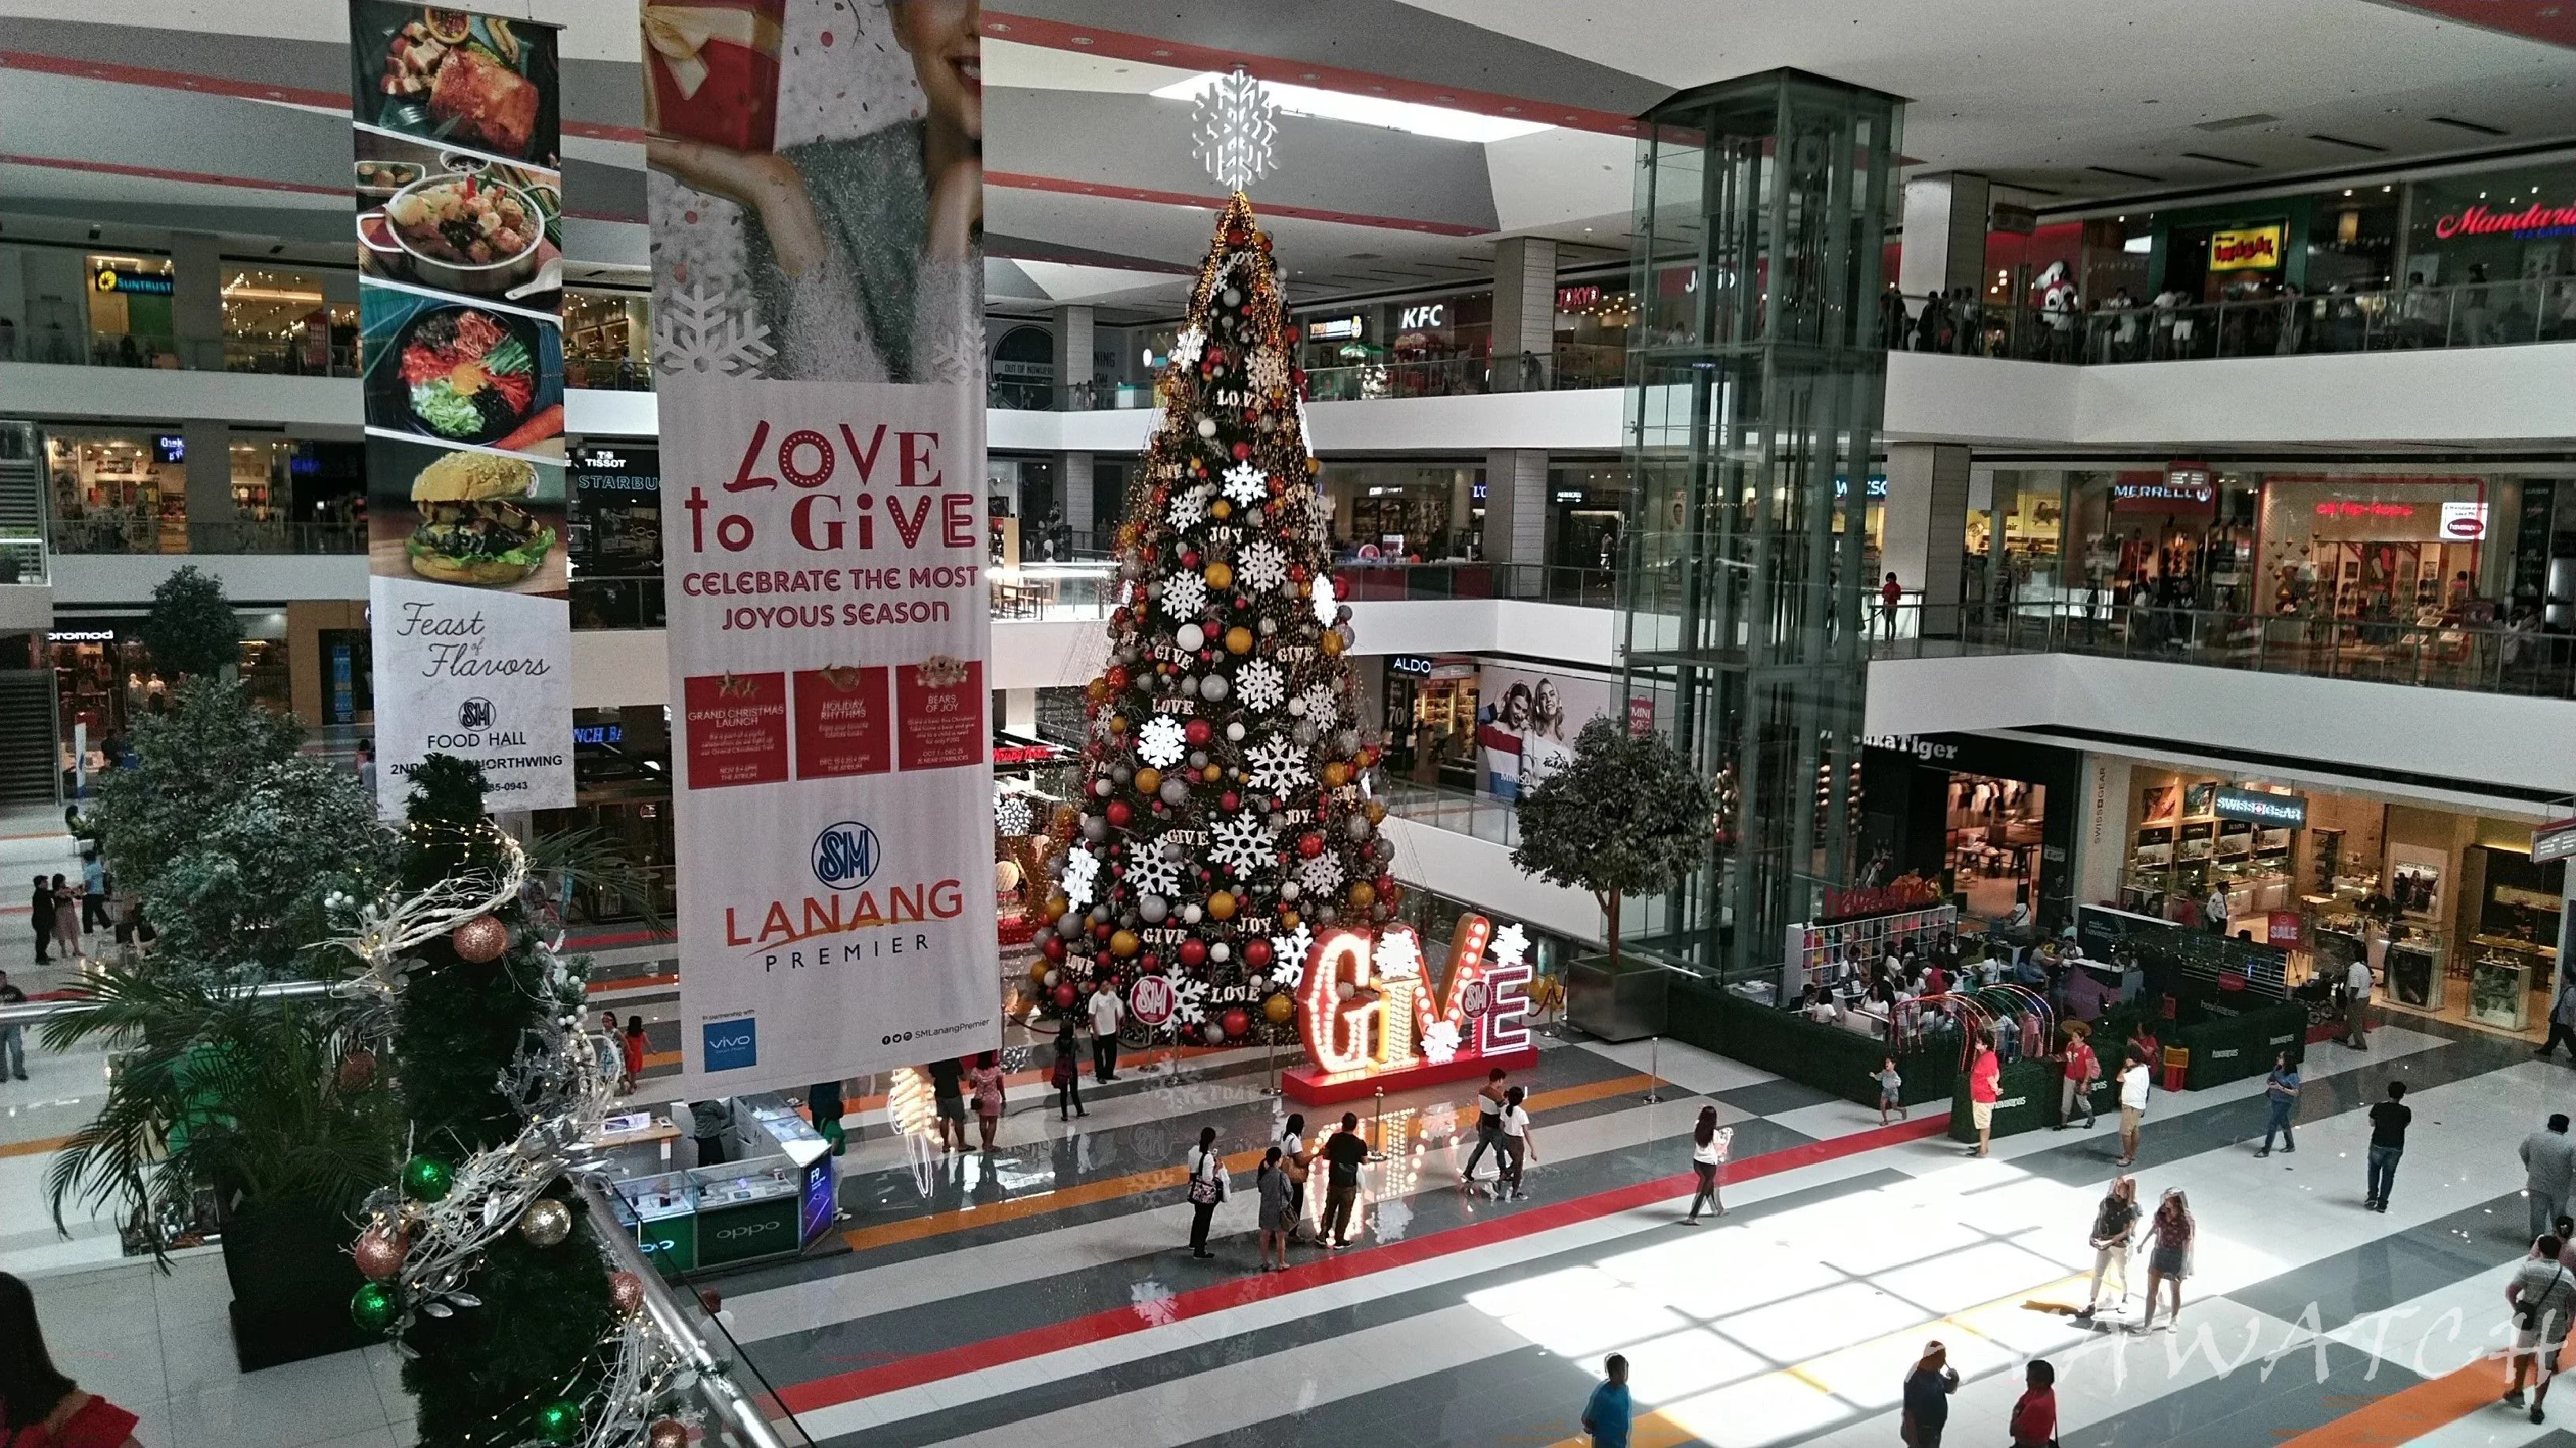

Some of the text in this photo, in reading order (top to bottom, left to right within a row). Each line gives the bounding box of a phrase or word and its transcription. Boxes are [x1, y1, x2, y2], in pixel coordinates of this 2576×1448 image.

[118, 277, 171, 291] SUNTRUST
[1556, 286, 1601, 306] TOKYO
[1401, 305, 1443, 329] KFC
[1217, 387, 1255, 407] LOV
[585, 458, 627, 467] TISSOT
[723, 420, 942, 492] LOVE
[578, 475, 661, 490] STARBU
[2115, 485, 2193, 498] MERRELL
[684, 486, 754, 552] to
[1209, 526, 1242, 543] JOY
[683, 566, 979, 596] CELEBRATE THE MOST
[397, 602, 485, 636] Feast
[722, 601, 949, 630] JOYOUS SEASON
[472, 638, 485, 656] of
[1276, 646, 1314, 663] GIVE
[421, 643, 550, 677] Flavors
[1154, 645, 1194, 671] GIVE
[1393, 657, 1431, 673] ALDO
[822, 698, 865, 712] HOLIDAY
[928, 694, 957, 705] BEARS
[941, 703, 959, 713] JOY
[1151, 698, 1194, 715] LOVE
[462, 702, 490, 727] SM
[688, 705, 784, 721] GRAND CHRISTMAS
[821, 709, 867, 720] RHYTHMS
[1631, 707, 1650, 719] MINI
[716, 717, 758, 728] LAUNCH
[428, 731, 526, 748] FOOD HALL
[1501, 773, 1530, 785] MINISO
[1286, 809, 1310, 825] JOY
[1166, 829, 1209, 846] GIVE
[818, 829, 871, 883] SM
[726, 879, 963, 947] LANANG
[1237, 916, 1271, 933] JOY
[2271, 926, 2297, 940] SALE
[1144, 928, 1188, 945] GIVE
[766, 934, 929, 972] PREMIER
[1065, 952, 1095, 975] LOVE
[1136, 979, 1167, 1015] SM
[1211, 986, 1260, 1003] LOVE
[1465, 986, 1487, 1012] SM
[915, 1019, 990, 1038] SMLanangPremier
[710, 1035, 750, 1048] vivo
[716, 1221, 780, 1240] oppo
